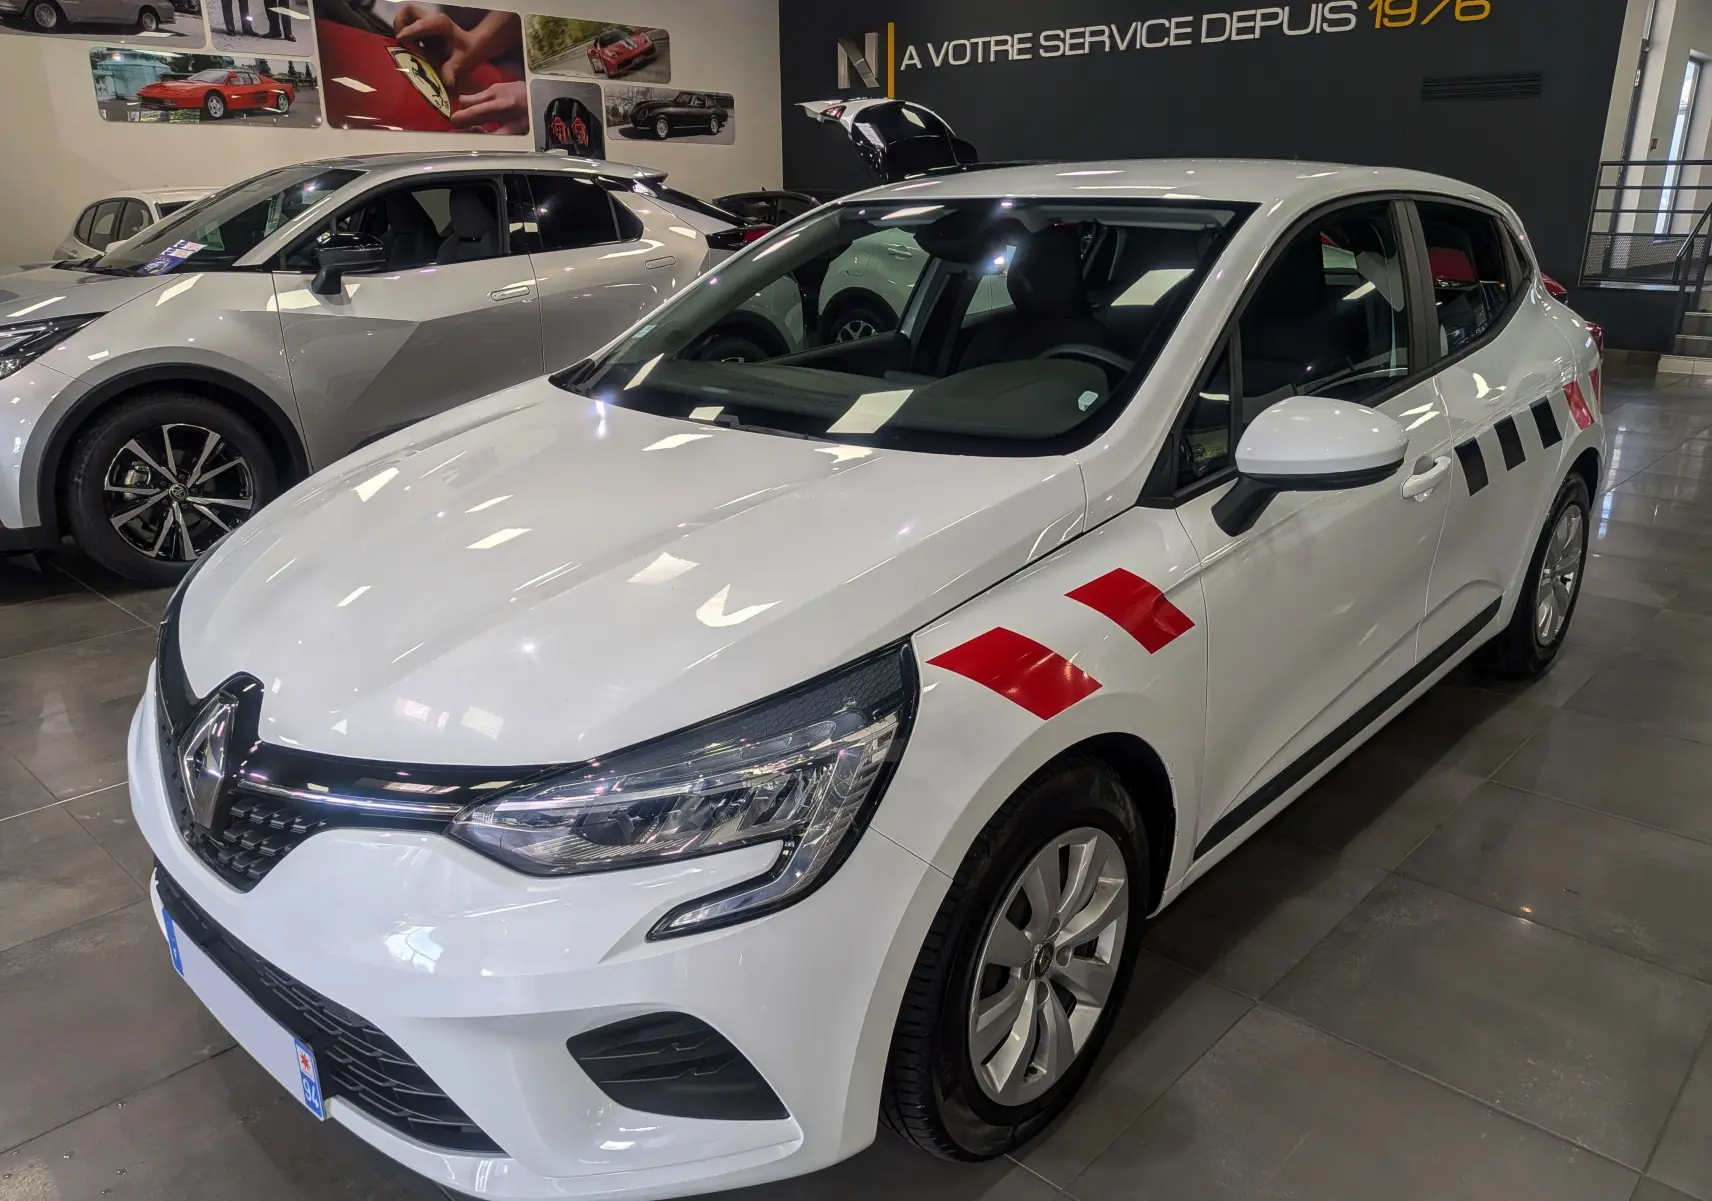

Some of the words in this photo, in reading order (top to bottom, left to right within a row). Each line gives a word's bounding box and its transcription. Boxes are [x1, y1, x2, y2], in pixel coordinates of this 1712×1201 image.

[837, 32, 880, 89] N
[900, 45, 922, 70] A
[927, 32, 1034, 67] VOTRE
[1039, 15, 1194, 58] SERVICE
[1200, 0, 1358, 43] DEPUIS
[302, 1077, 320, 1109] 94
